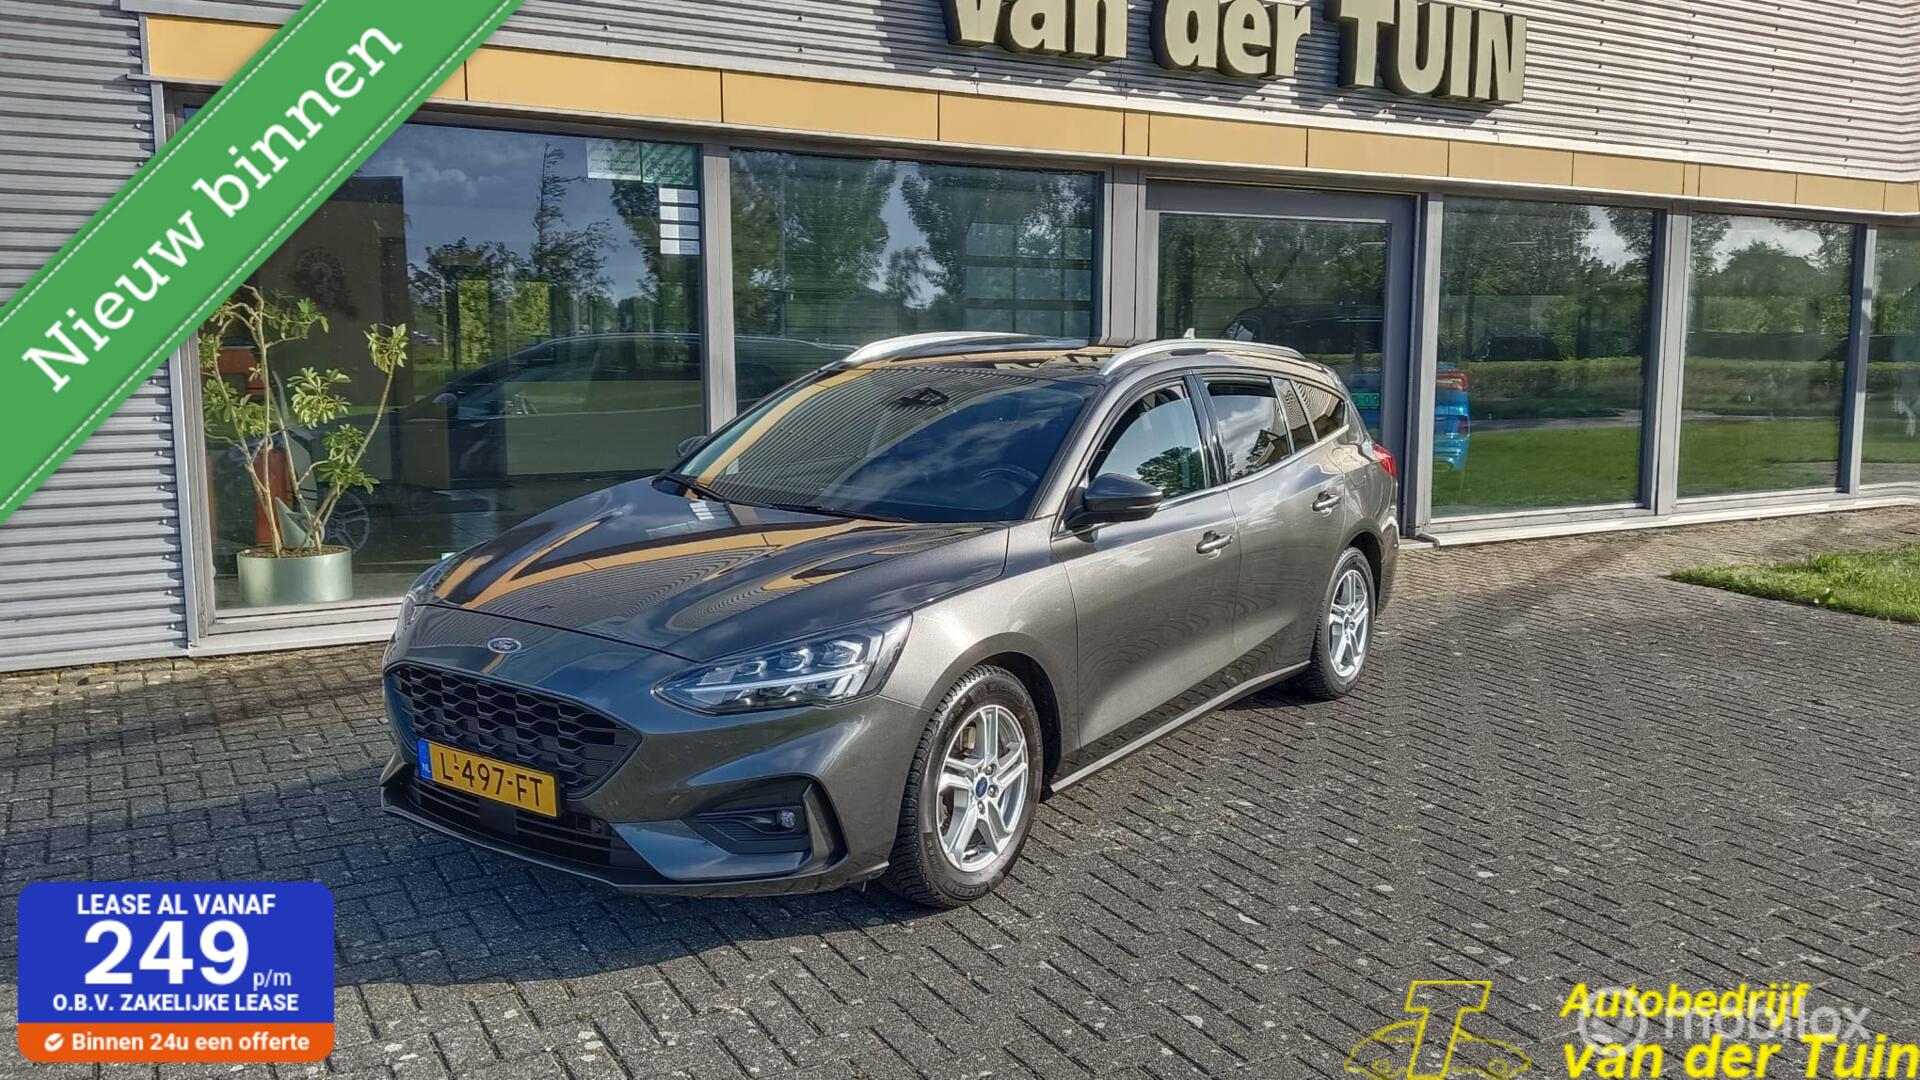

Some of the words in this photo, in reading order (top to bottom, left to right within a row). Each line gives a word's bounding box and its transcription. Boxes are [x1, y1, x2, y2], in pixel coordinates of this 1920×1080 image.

[954, 0, 1129, 58] van
[1164, 0, 1312, 76] der
[1339, 0, 1528, 103] TUIN
[440, 751, 543, 807] L-497-FT
